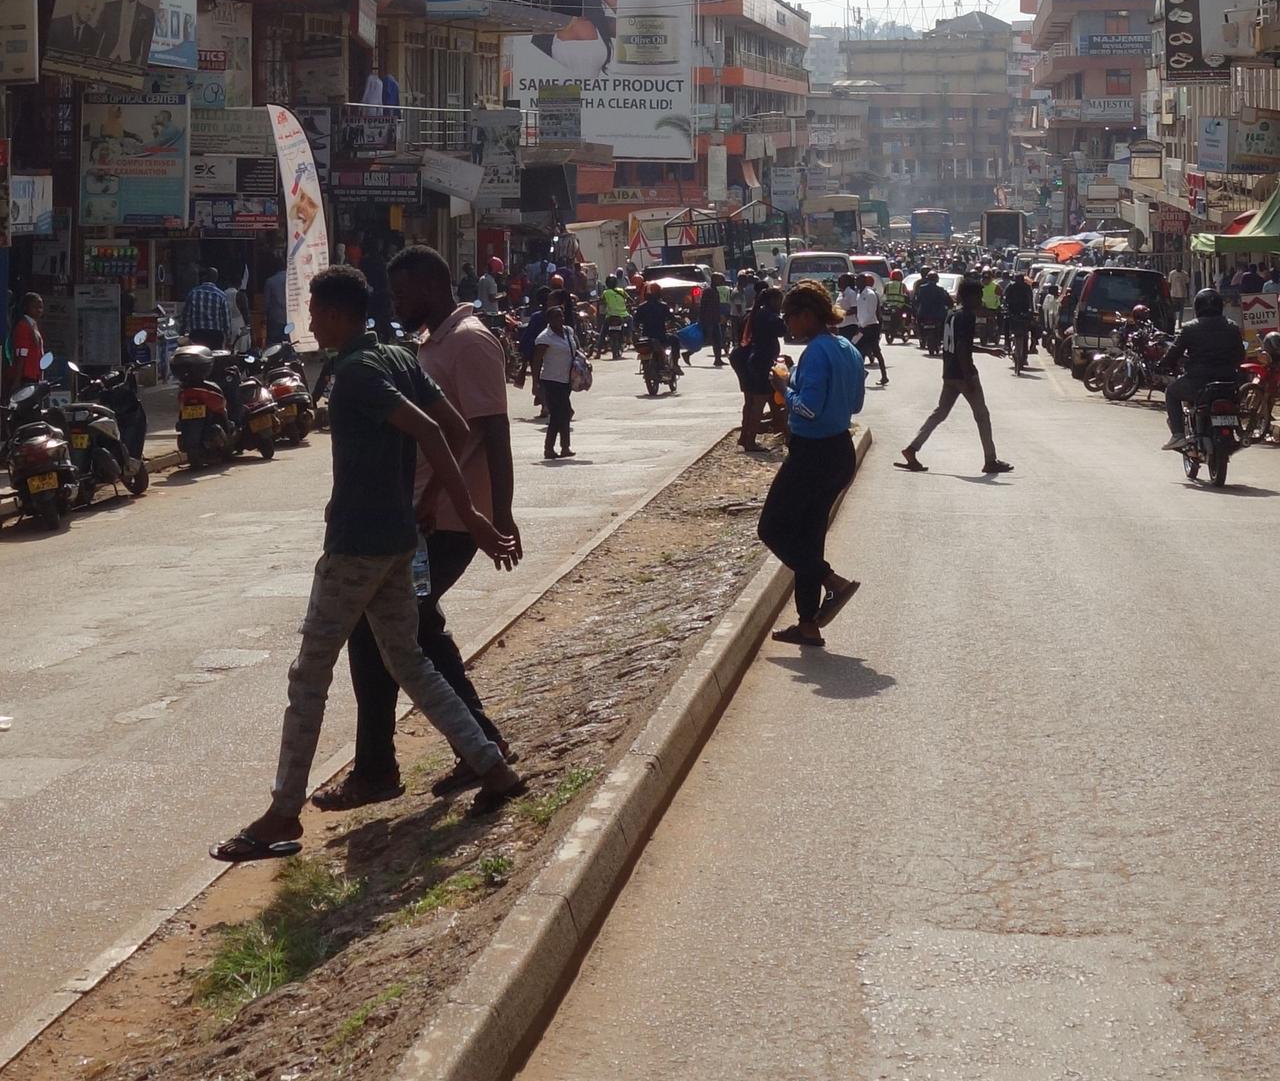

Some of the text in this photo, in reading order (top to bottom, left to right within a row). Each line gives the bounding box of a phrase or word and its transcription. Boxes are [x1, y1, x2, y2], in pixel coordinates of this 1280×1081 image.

[612, 79, 685, 93] PRODUCT
[146, 94, 179, 105] CENTER
[597, 99, 605, 108] A
[608, 99, 647, 109] CLEAR
[649, 99, 673, 110] LID!
[1089, 98, 1134, 112] MAJESTIC
[1243, 311, 1277, 320] EQUITY
